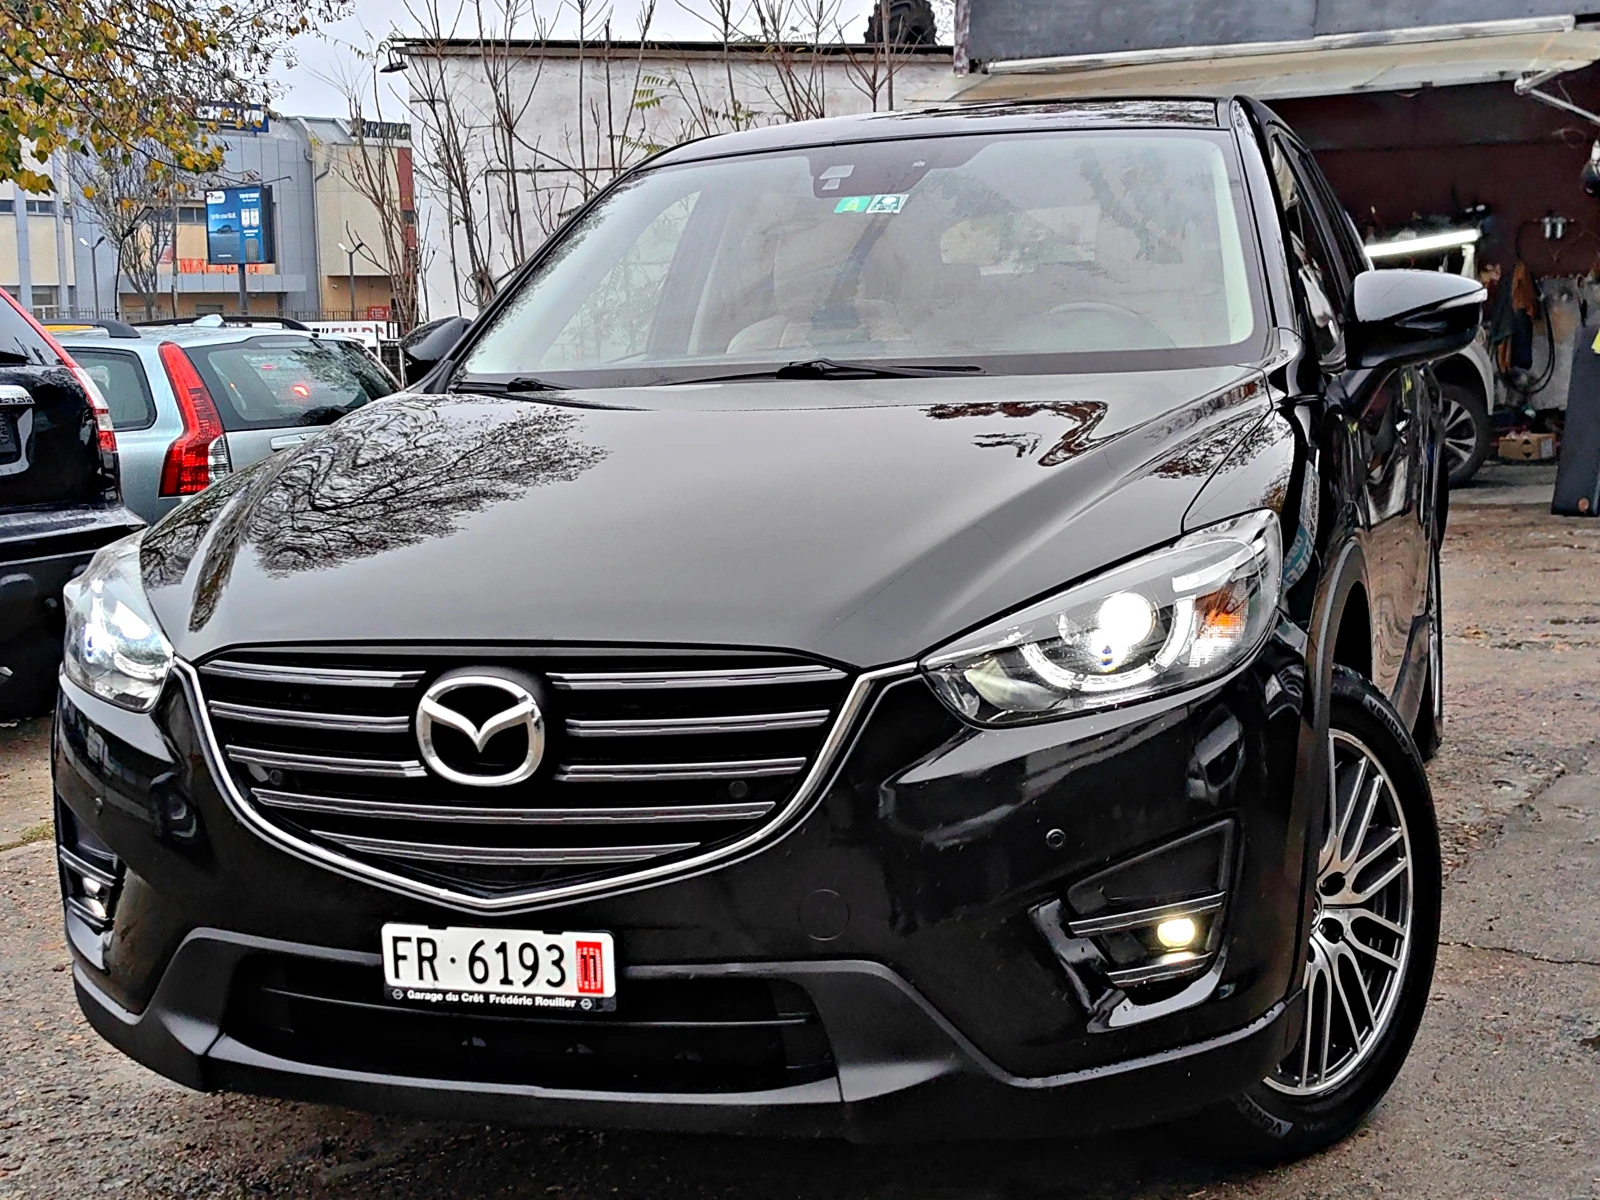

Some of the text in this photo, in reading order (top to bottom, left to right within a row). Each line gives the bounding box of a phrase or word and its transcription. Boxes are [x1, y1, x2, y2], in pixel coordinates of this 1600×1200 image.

[468, 939, 567, 988] 6193
[407, 990, 577, 1008] Garage du Crêt Frédéric Rouiller
